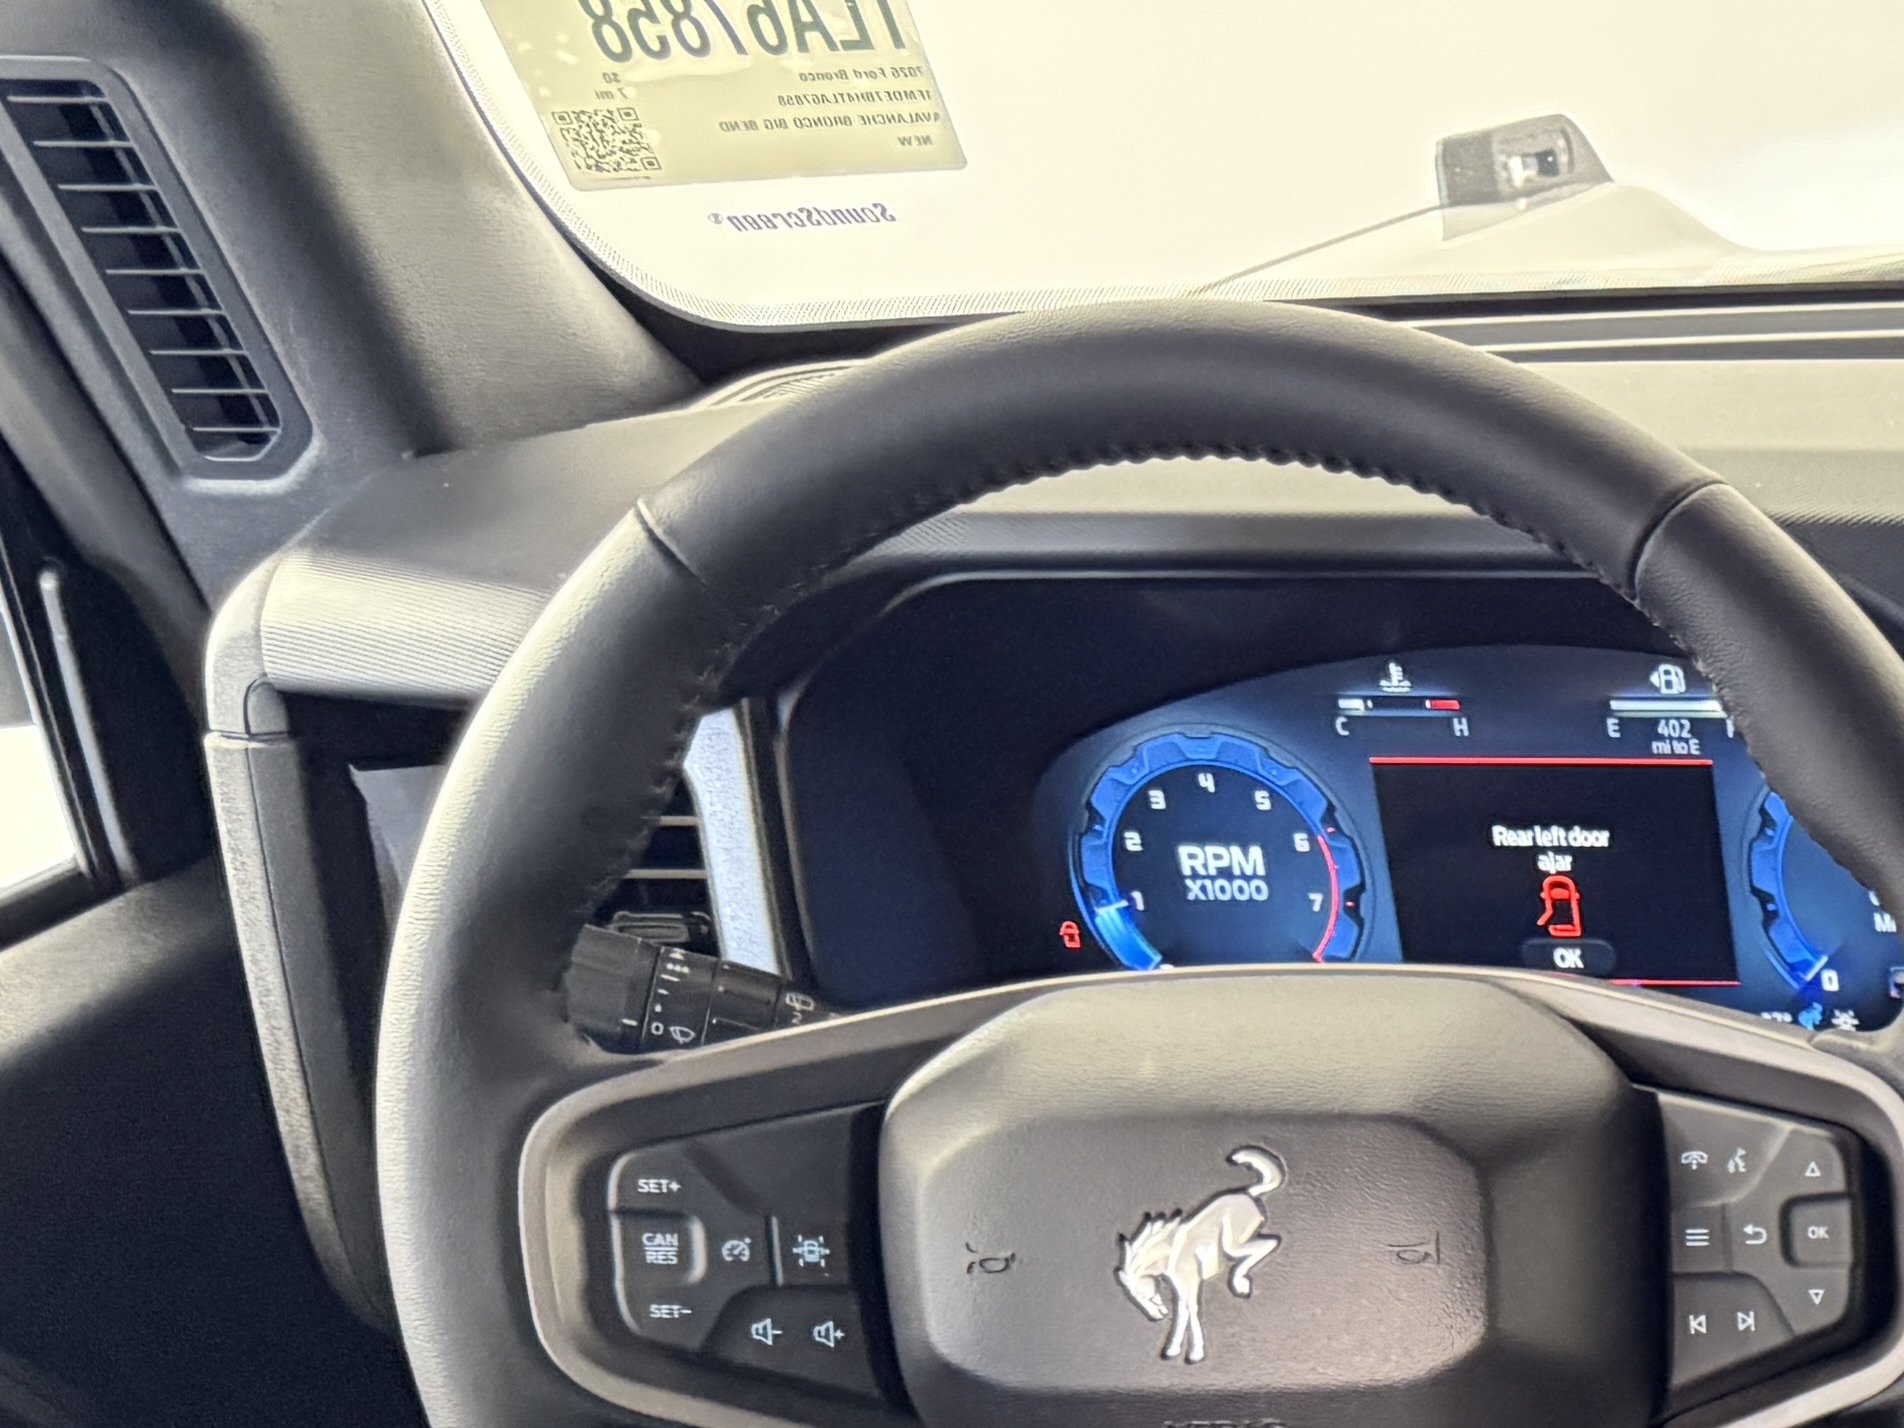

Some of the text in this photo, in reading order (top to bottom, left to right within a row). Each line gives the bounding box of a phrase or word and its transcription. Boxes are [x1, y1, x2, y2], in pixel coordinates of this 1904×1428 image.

[1335, 716, 1350, 737] C
[1453, 716, 1470, 737] H
[1606, 717, 1622, 738] E
[1656, 718, 1692, 739] 402
[1198, 772, 1216, 793] 4
[1148, 790, 1167, 810] 3
[1254, 790, 1272, 811] 5
[1123, 831, 1143, 851] 2
[1293, 832, 1311, 852] 6
[1491, 825, 1610, 848] Rear left door
[1177, 844, 1267, 876] RPM
[1537, 851, 1573, 875] ajar
[1184, 878, 1270, 902] X1000
[1307, 892, 1324, 912] 7
[1552, 947, 1585, 969] OK
[637, 1178, 682, 1194] SET+
[641, 1232, 679, 1247] CAN
[1807, 1225, 1830, 1240] OK
[645, 1251, 679, 1265] RES
